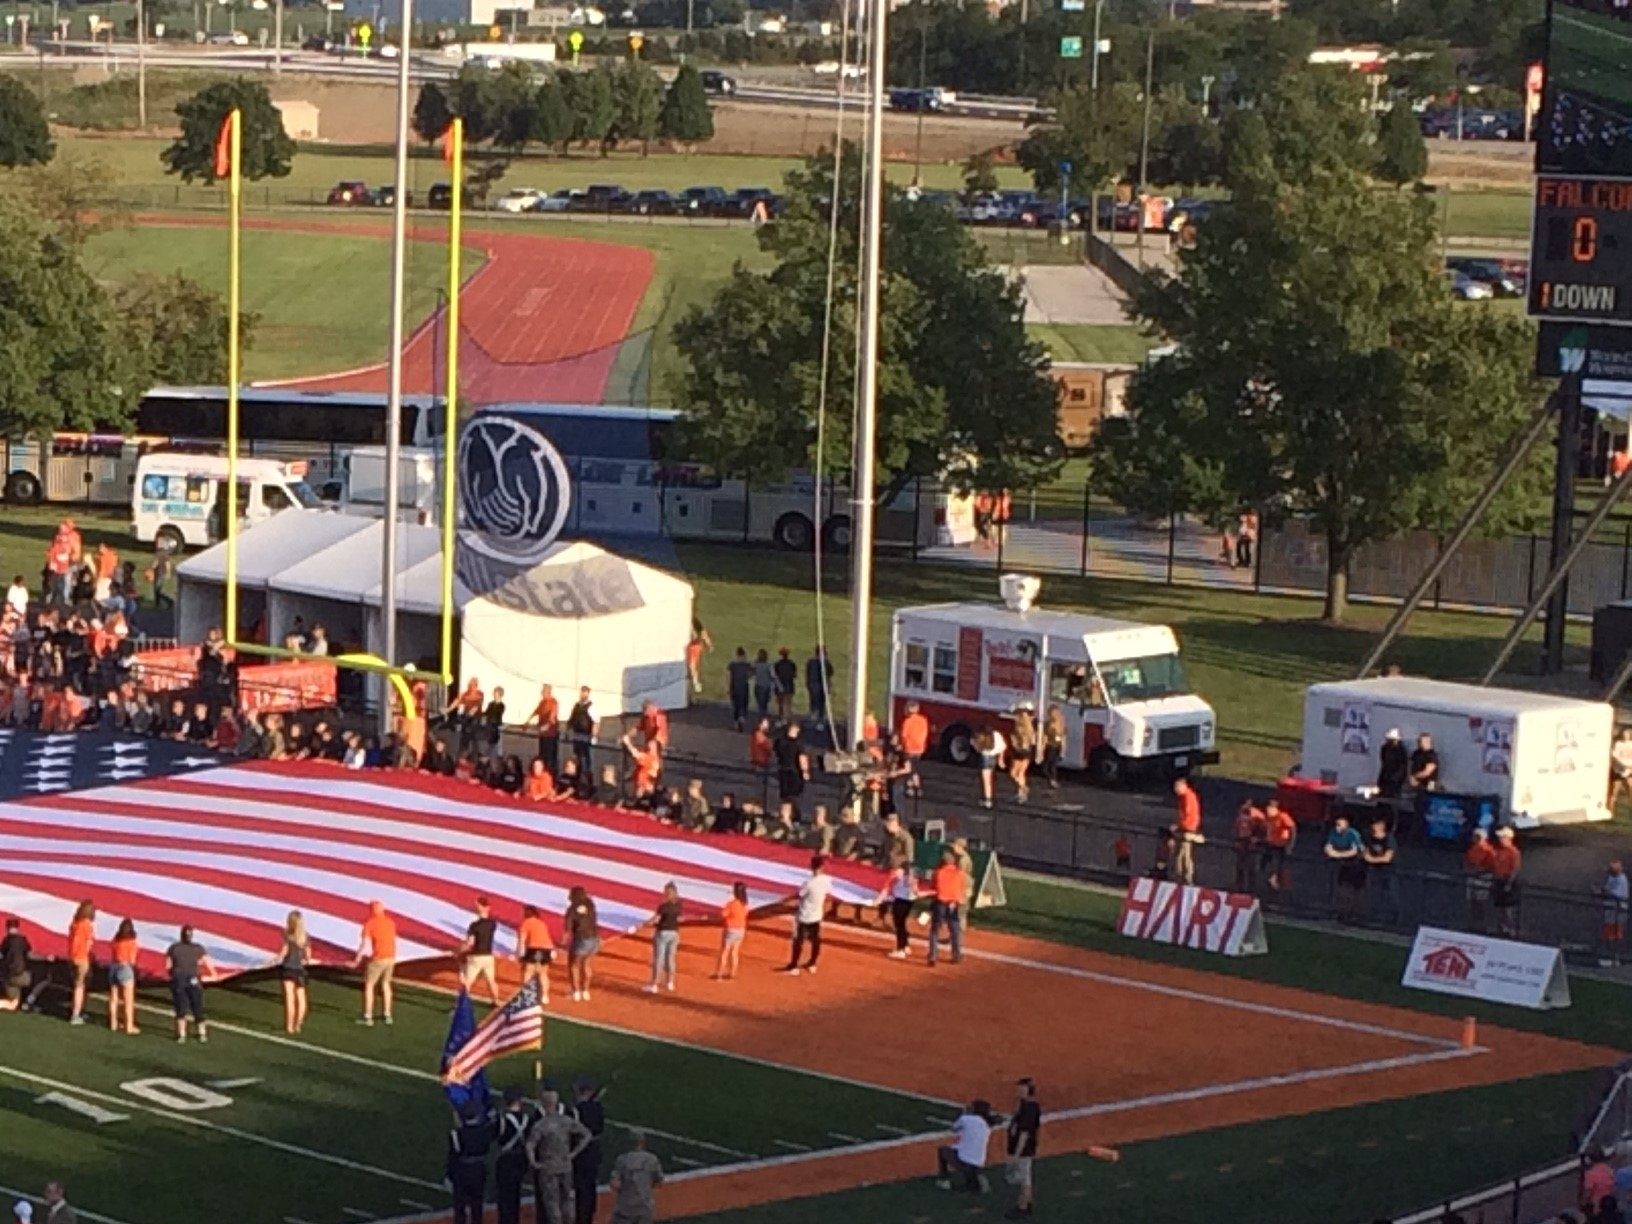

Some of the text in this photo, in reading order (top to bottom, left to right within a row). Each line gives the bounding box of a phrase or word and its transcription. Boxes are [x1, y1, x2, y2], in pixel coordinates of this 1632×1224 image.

[1572, 216, 1598, 263] 0
[1553, 283, 1615, 310] DOWN
[1116, 877, 1255, 953] HART
[35, 1076, 235, 1125] 10
